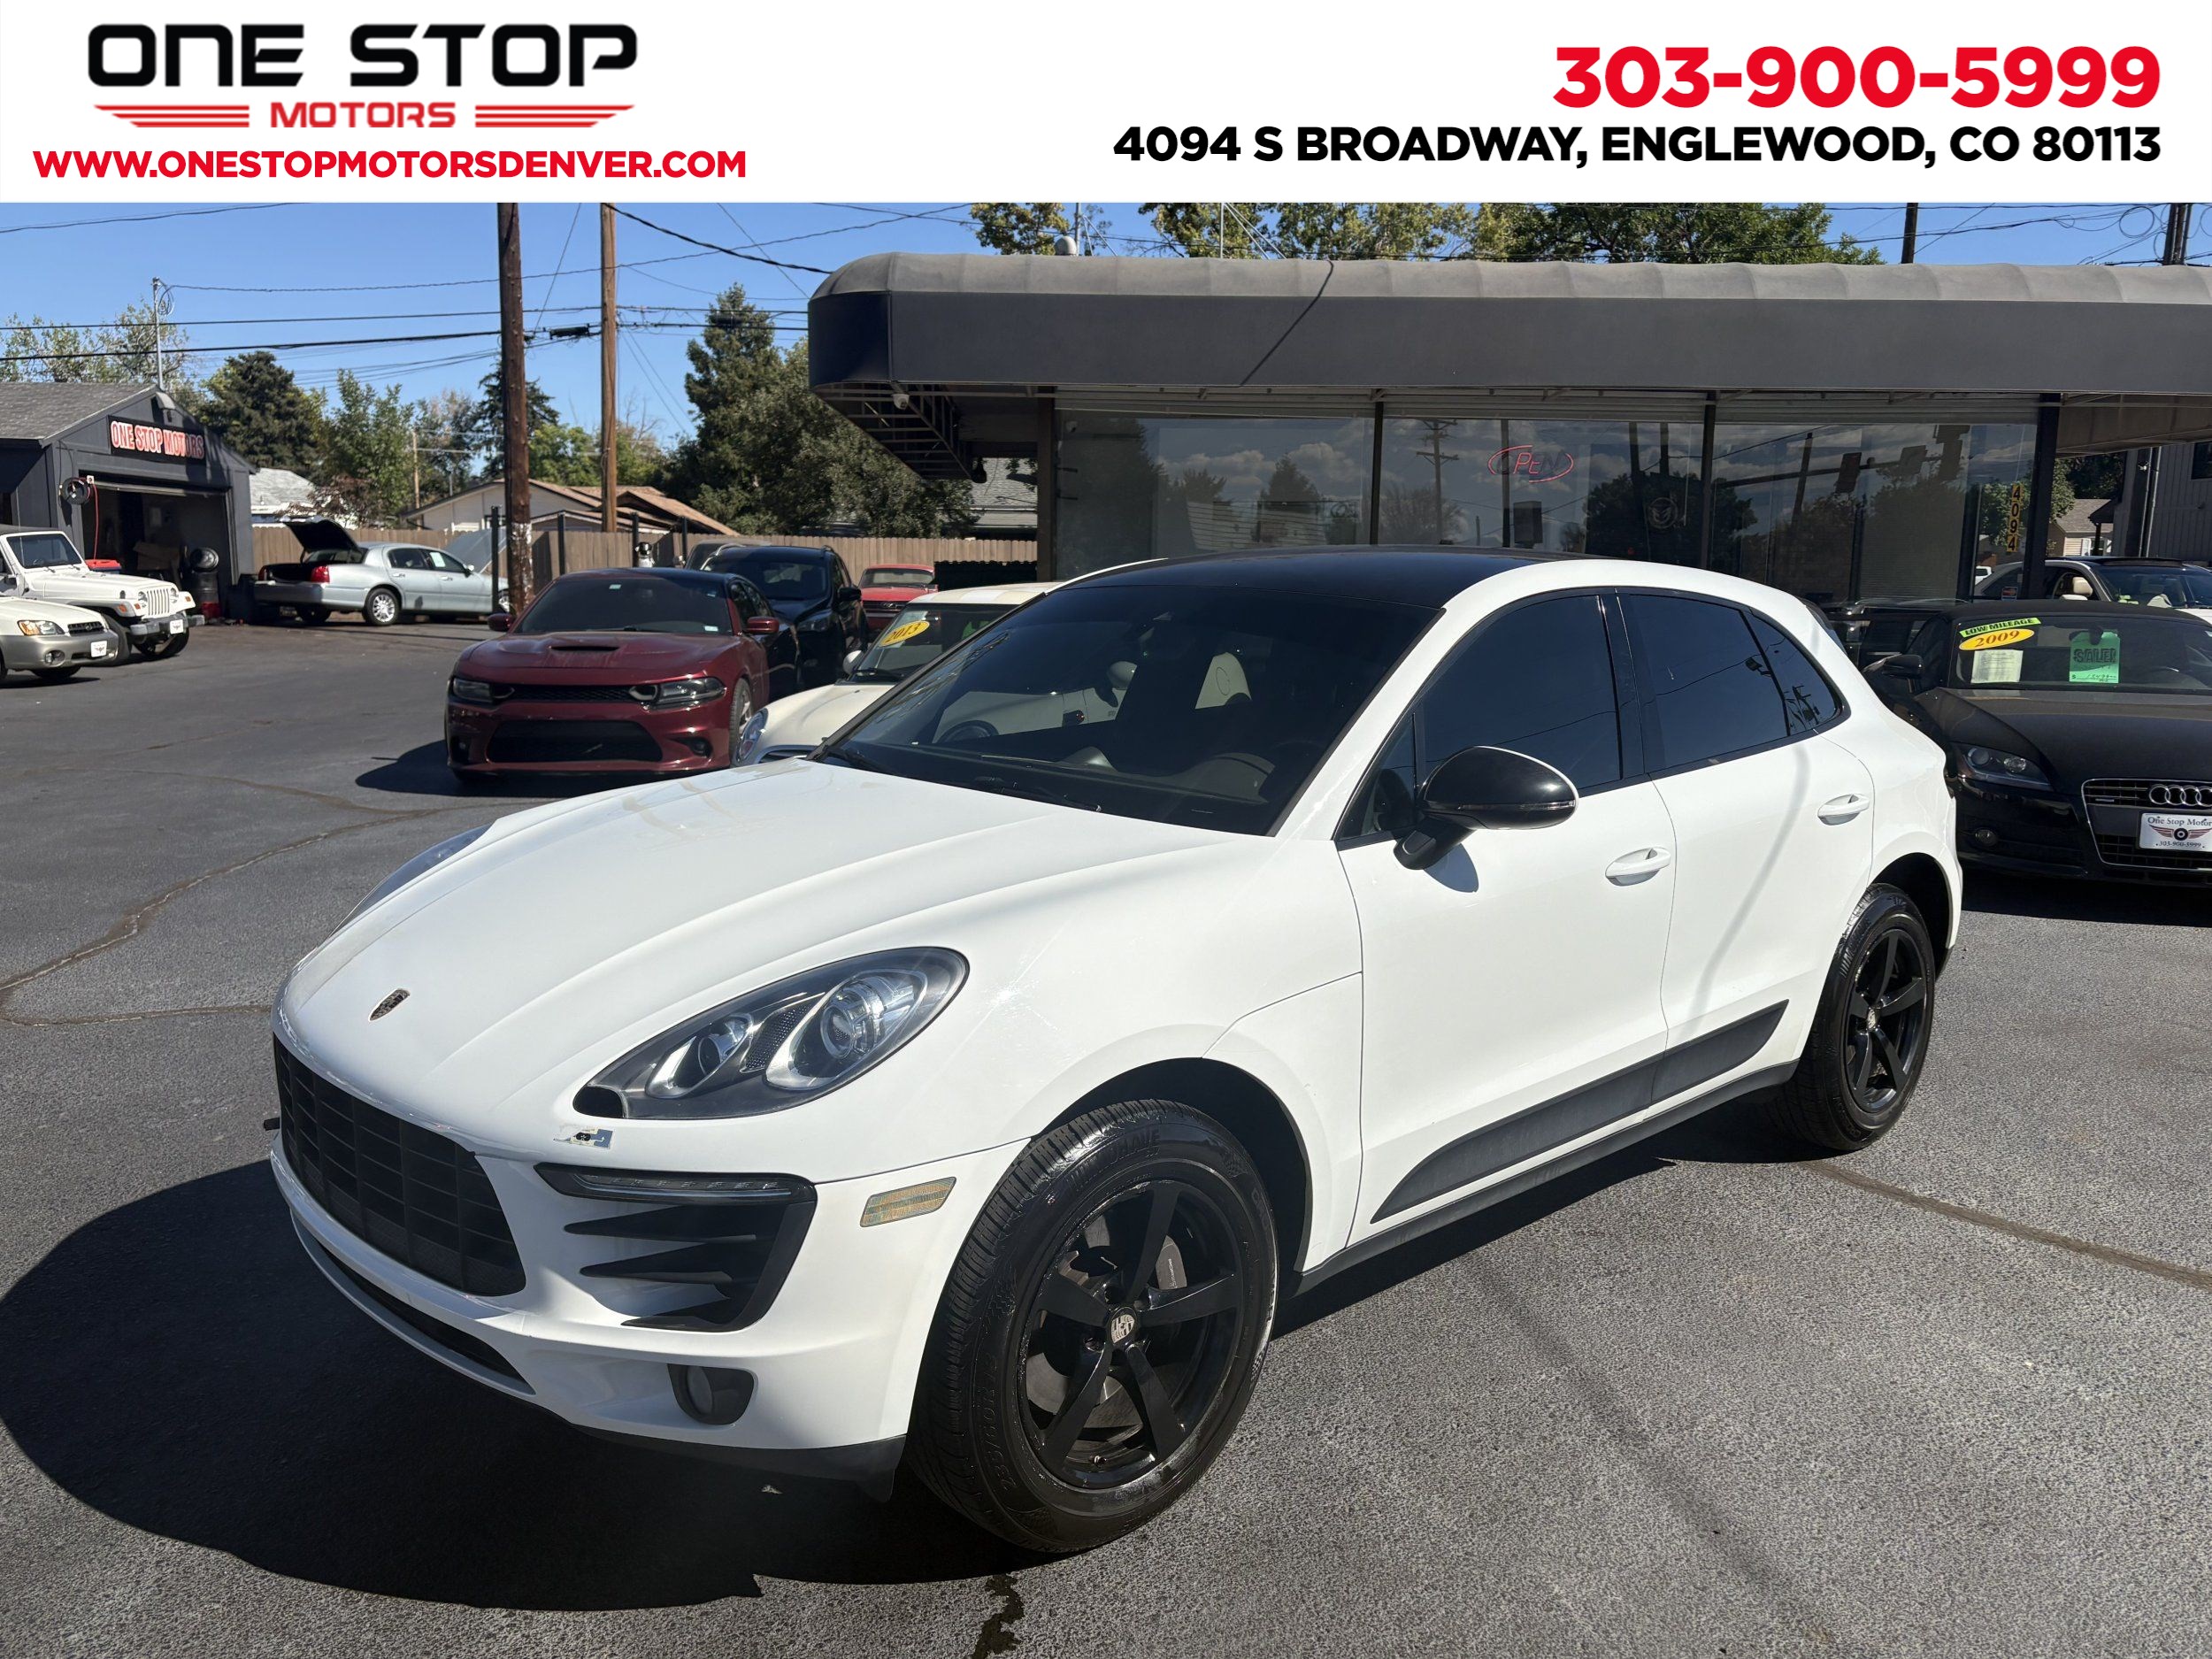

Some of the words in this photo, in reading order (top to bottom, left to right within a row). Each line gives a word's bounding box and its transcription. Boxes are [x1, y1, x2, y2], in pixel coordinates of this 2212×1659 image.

[111, 421, 135, 449] ONE
[134, 425, 163, 453] STOP
[163, 429, 205, 459] MOTORS
[2008, 486, 2021, 550] 4094
[885, 622, 921, 642] 2013
[1965, 626, 1988, 635] LOW
[1989, 618, 2034, 630] MILEAGE
[1974, 630, 2020, 648] 2009
[2166, 818, 2185, 826] Stop
